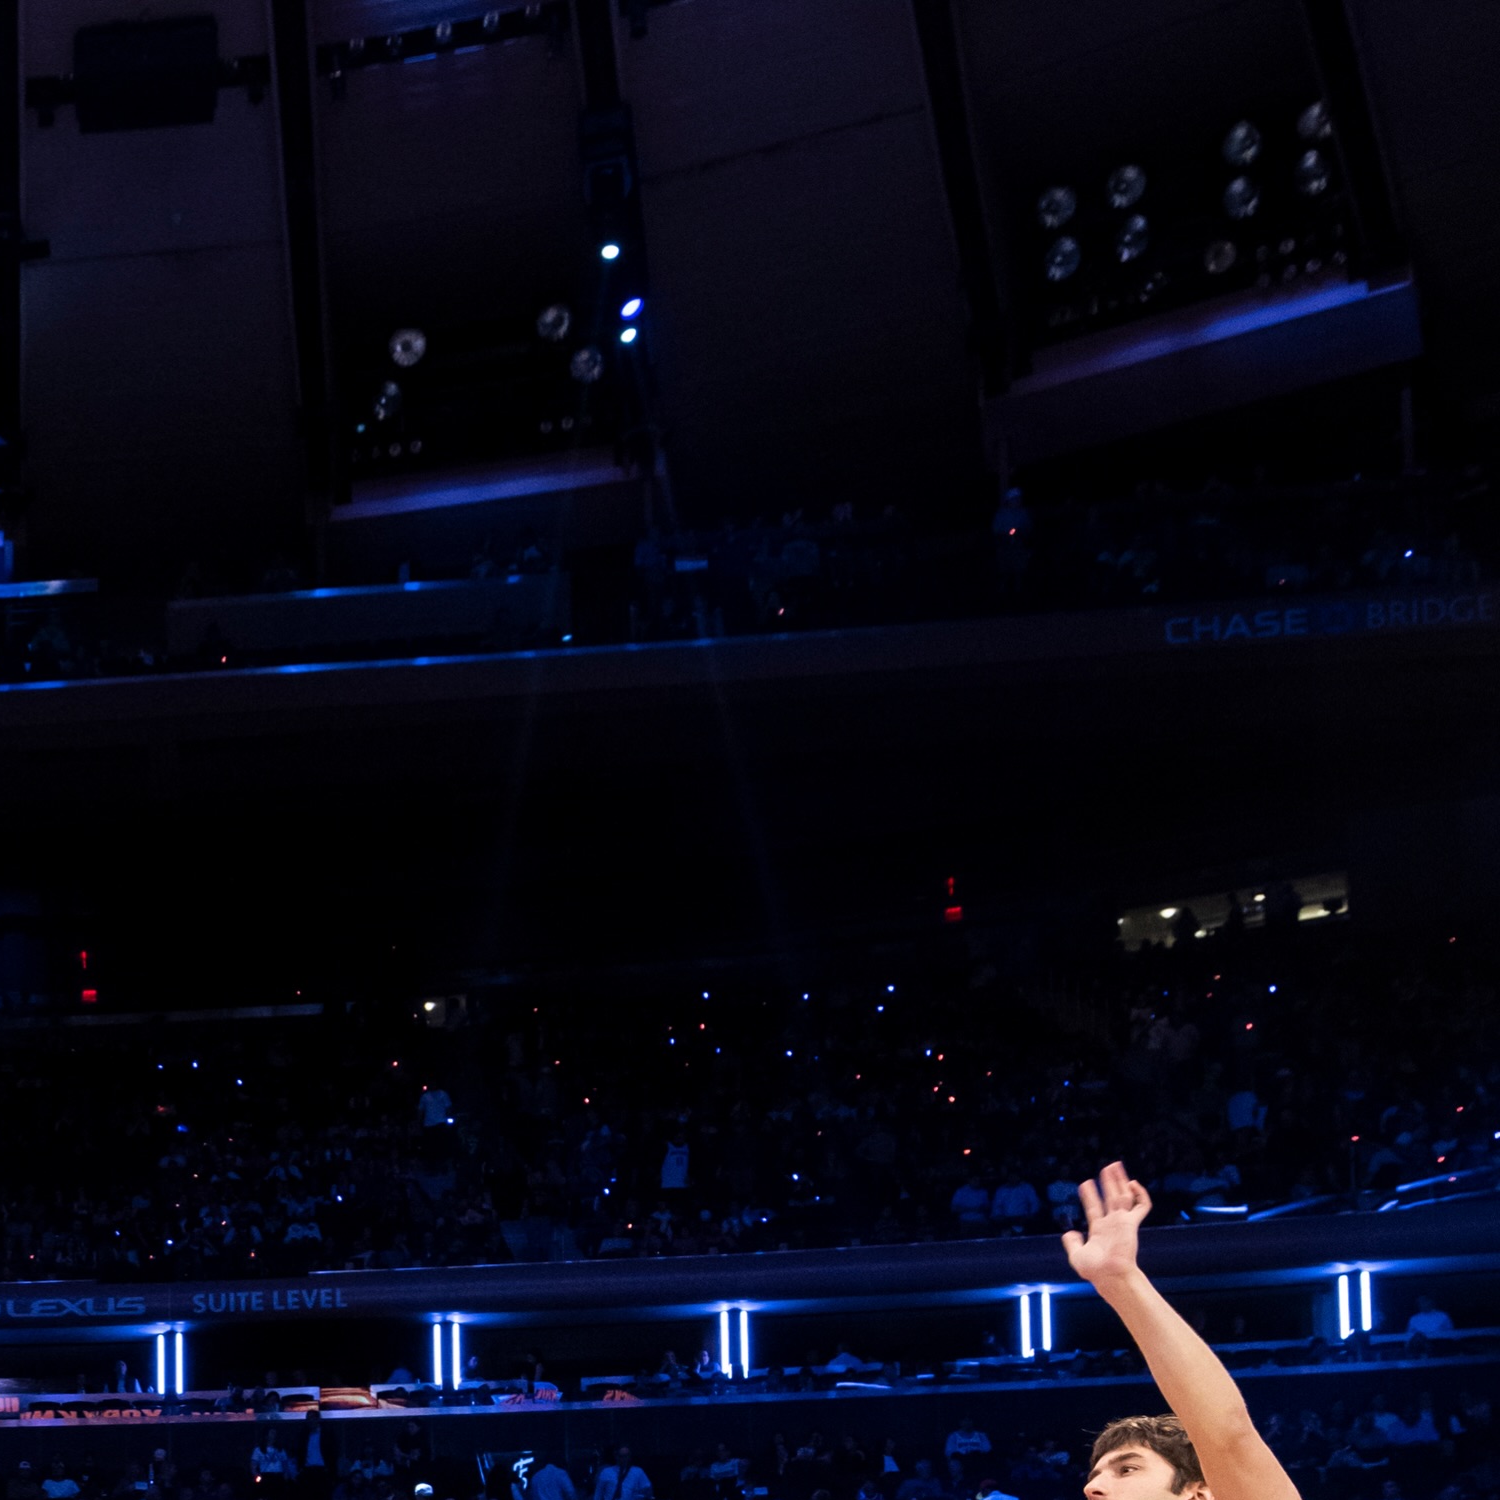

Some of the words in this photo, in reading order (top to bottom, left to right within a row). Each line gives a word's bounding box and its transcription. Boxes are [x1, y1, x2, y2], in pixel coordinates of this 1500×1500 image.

[1164, 608, 1308, 644] CHASE
[1365, 594, 1494, 630] BRIDGE
[7, 1296, 147, 1318] LEXUS
[192, 1290, 264, 1314] SUITE
[273, 1287, 348, 1311] LEVEL
